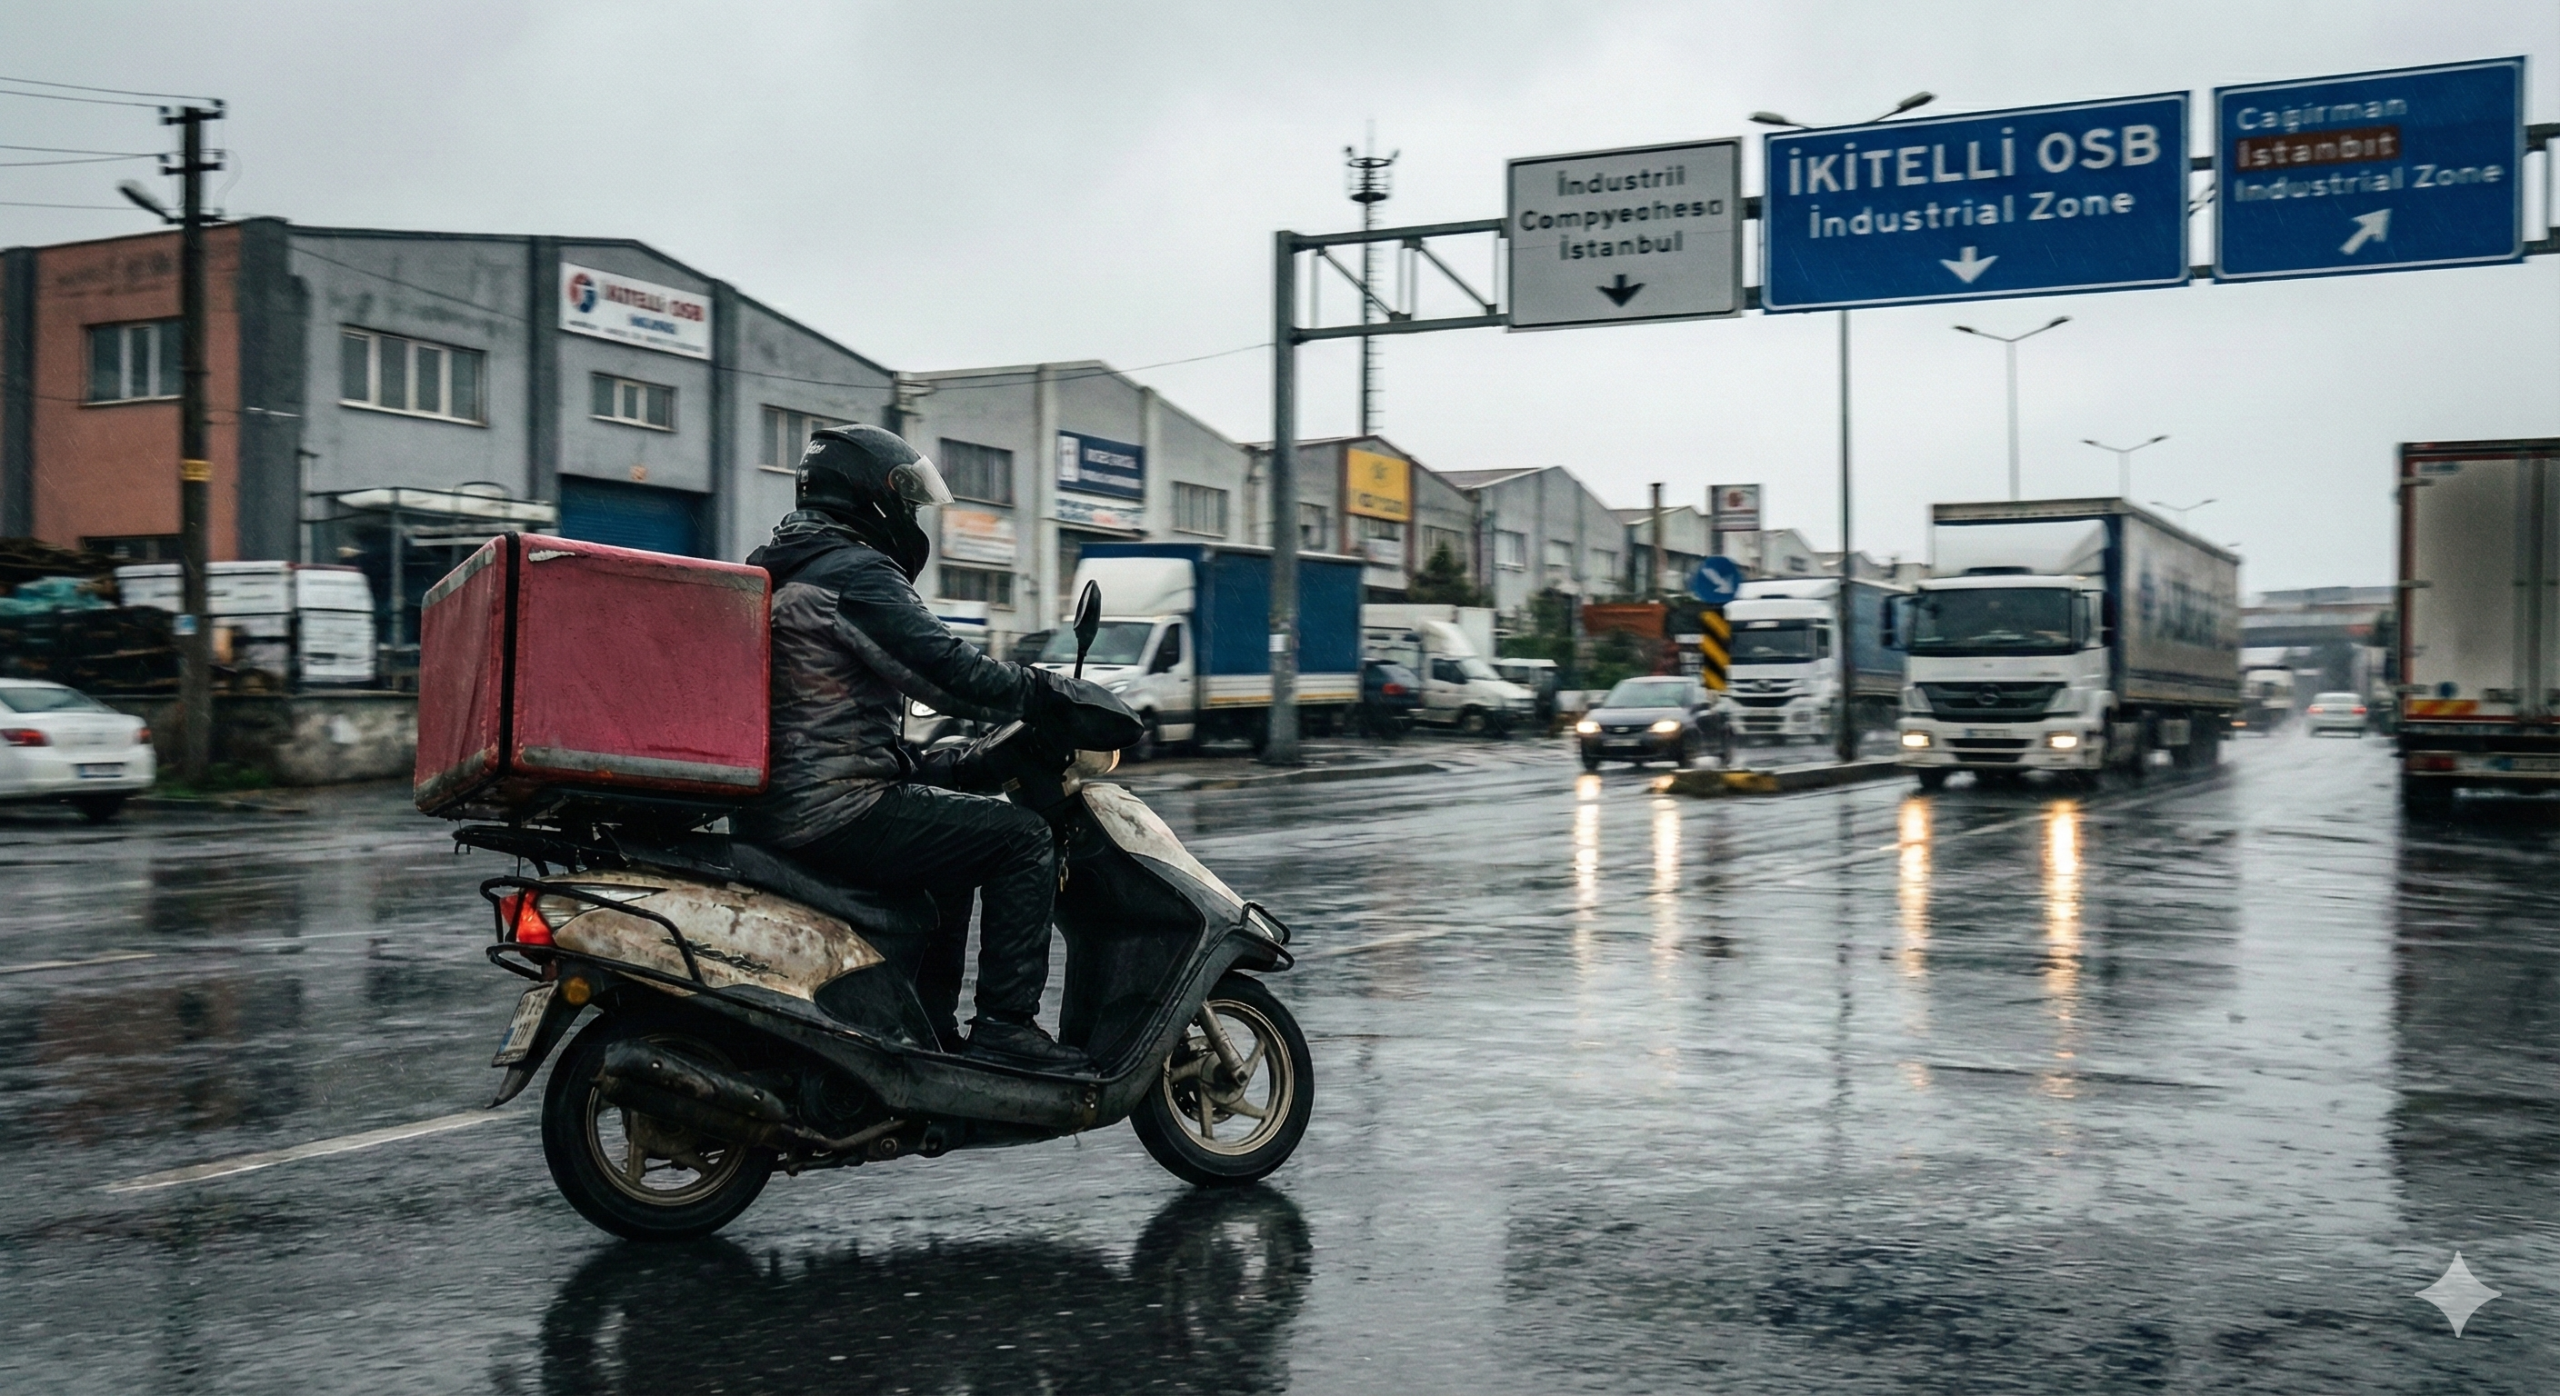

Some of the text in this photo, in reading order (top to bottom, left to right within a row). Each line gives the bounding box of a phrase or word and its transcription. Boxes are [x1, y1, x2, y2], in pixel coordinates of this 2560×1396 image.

[1788, 124, 2161, 196] İKİTELLİ OSB
[2411, 163, 2505, 189] Zone
[2028, 191, 2136, 222] Zone
